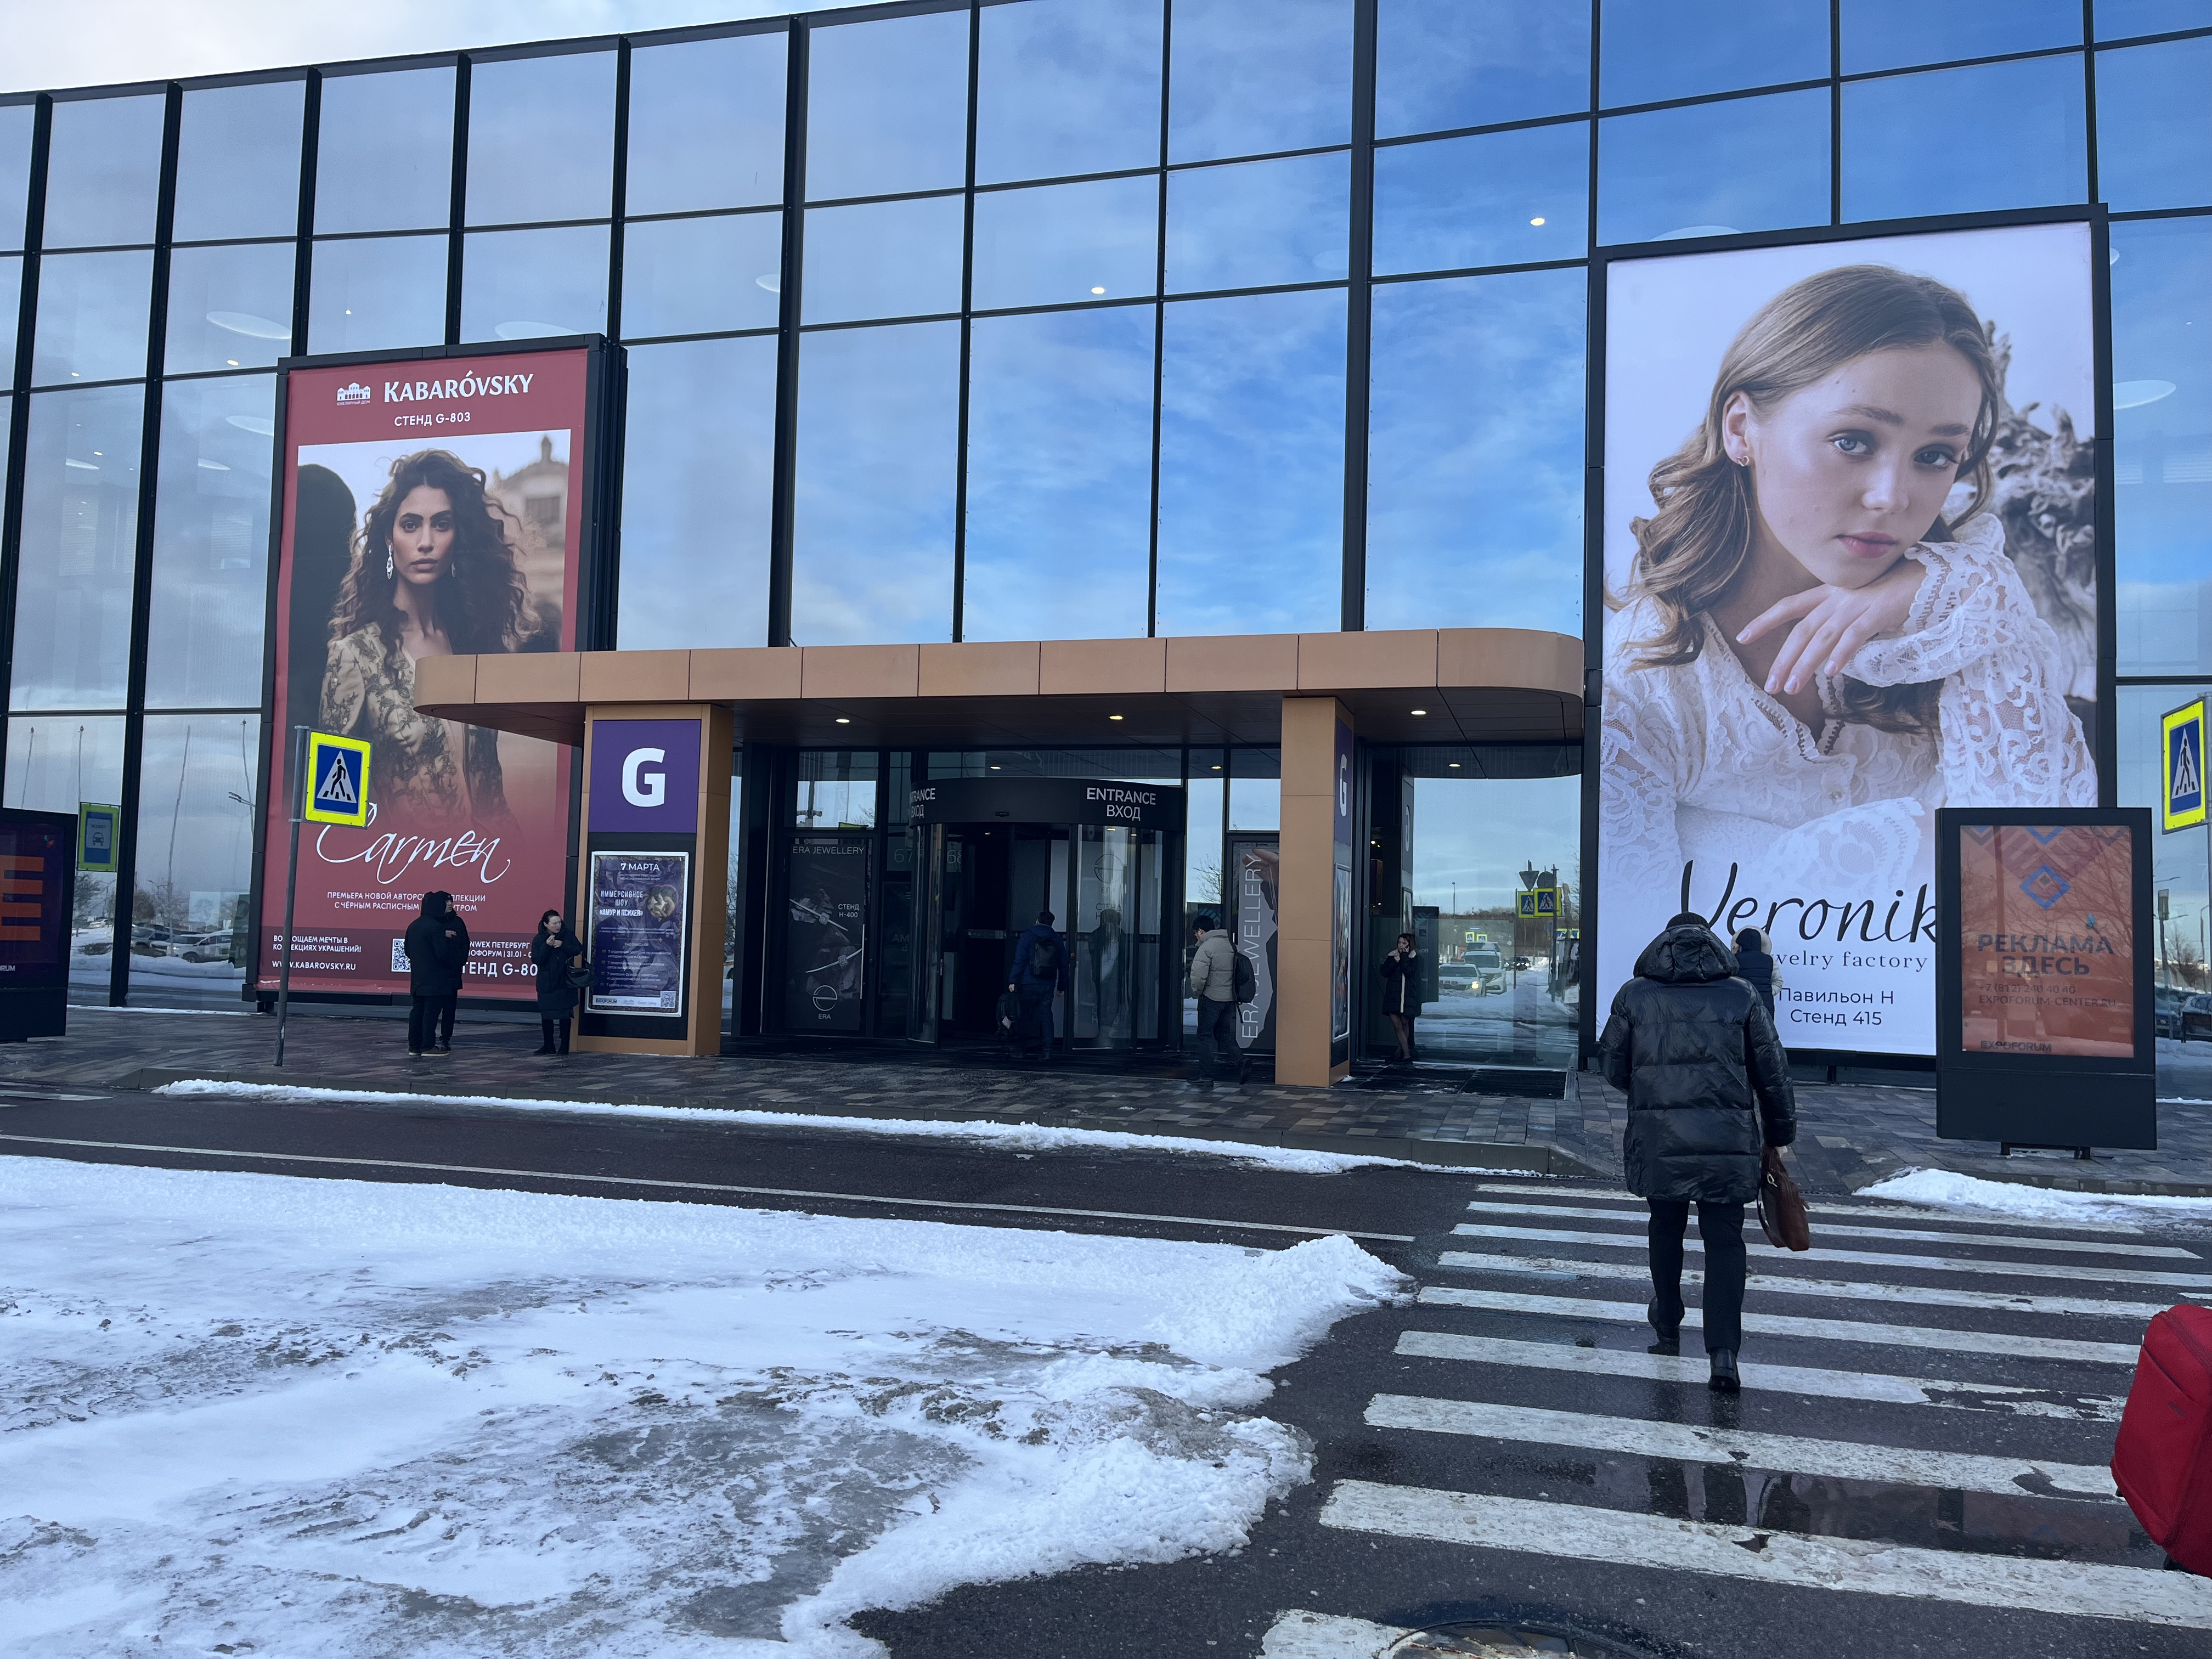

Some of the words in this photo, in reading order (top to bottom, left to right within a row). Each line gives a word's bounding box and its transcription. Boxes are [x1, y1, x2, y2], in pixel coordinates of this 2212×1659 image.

[384, 370, 534, 403] KABARÓVSKY
[394, 414, 432, 426] СТЕНД
[436, 411, 471, 424] G-803
[622, 747, 665, 807] G
[1086, 787, 1156, 805] ENTRANCE
[1106, 804, 1141, 822] ВХОД
[620, 862, 627, 871] 7
[628, 863, 660, 871] МАРТА
[365, 891, 392, 900] НОВОЙ
[600, 890, 644, 898] ИММЕРСИВНОЕ
[1681, 859, 1937, 944] Veronik
[341, 900, 371, 910] ЧЁРНЫМ
[372, 902, 420, 911] РАСПИСНЫМ
[273, 935, 318, 944] ВООЩАЕМ
[1978, 934, 2114, 955] РЕКЛАМА
[273, 944, 317, 952] КОЕКЦИЯХ
[318, 945, 362, 953] УКРАШЕНИЙ!
[469, 949, 503, 957] ОФОРУМ
[462, 961, 498, 978] ТЕНД
[502, 962, 538, 977] G-80
[1771, 950, 1834, 970] welry
[1842, 951, 1928, 973] factory
[2001, 955, 2090, 979] ЗДЕСЬ
[1779, 988, 1873, 1005] Павильон
[1994, 984, 2021, 994] (812)
[2046, 985, 2060, 994] 40
[2062, 985, 2076, 994] 40
[1790, 1009, 1847, 1026] Стенд
[1853, 1011, 1882, 1025] 415
[1980, 1040, 2052, 1052] EXPOFORUM
